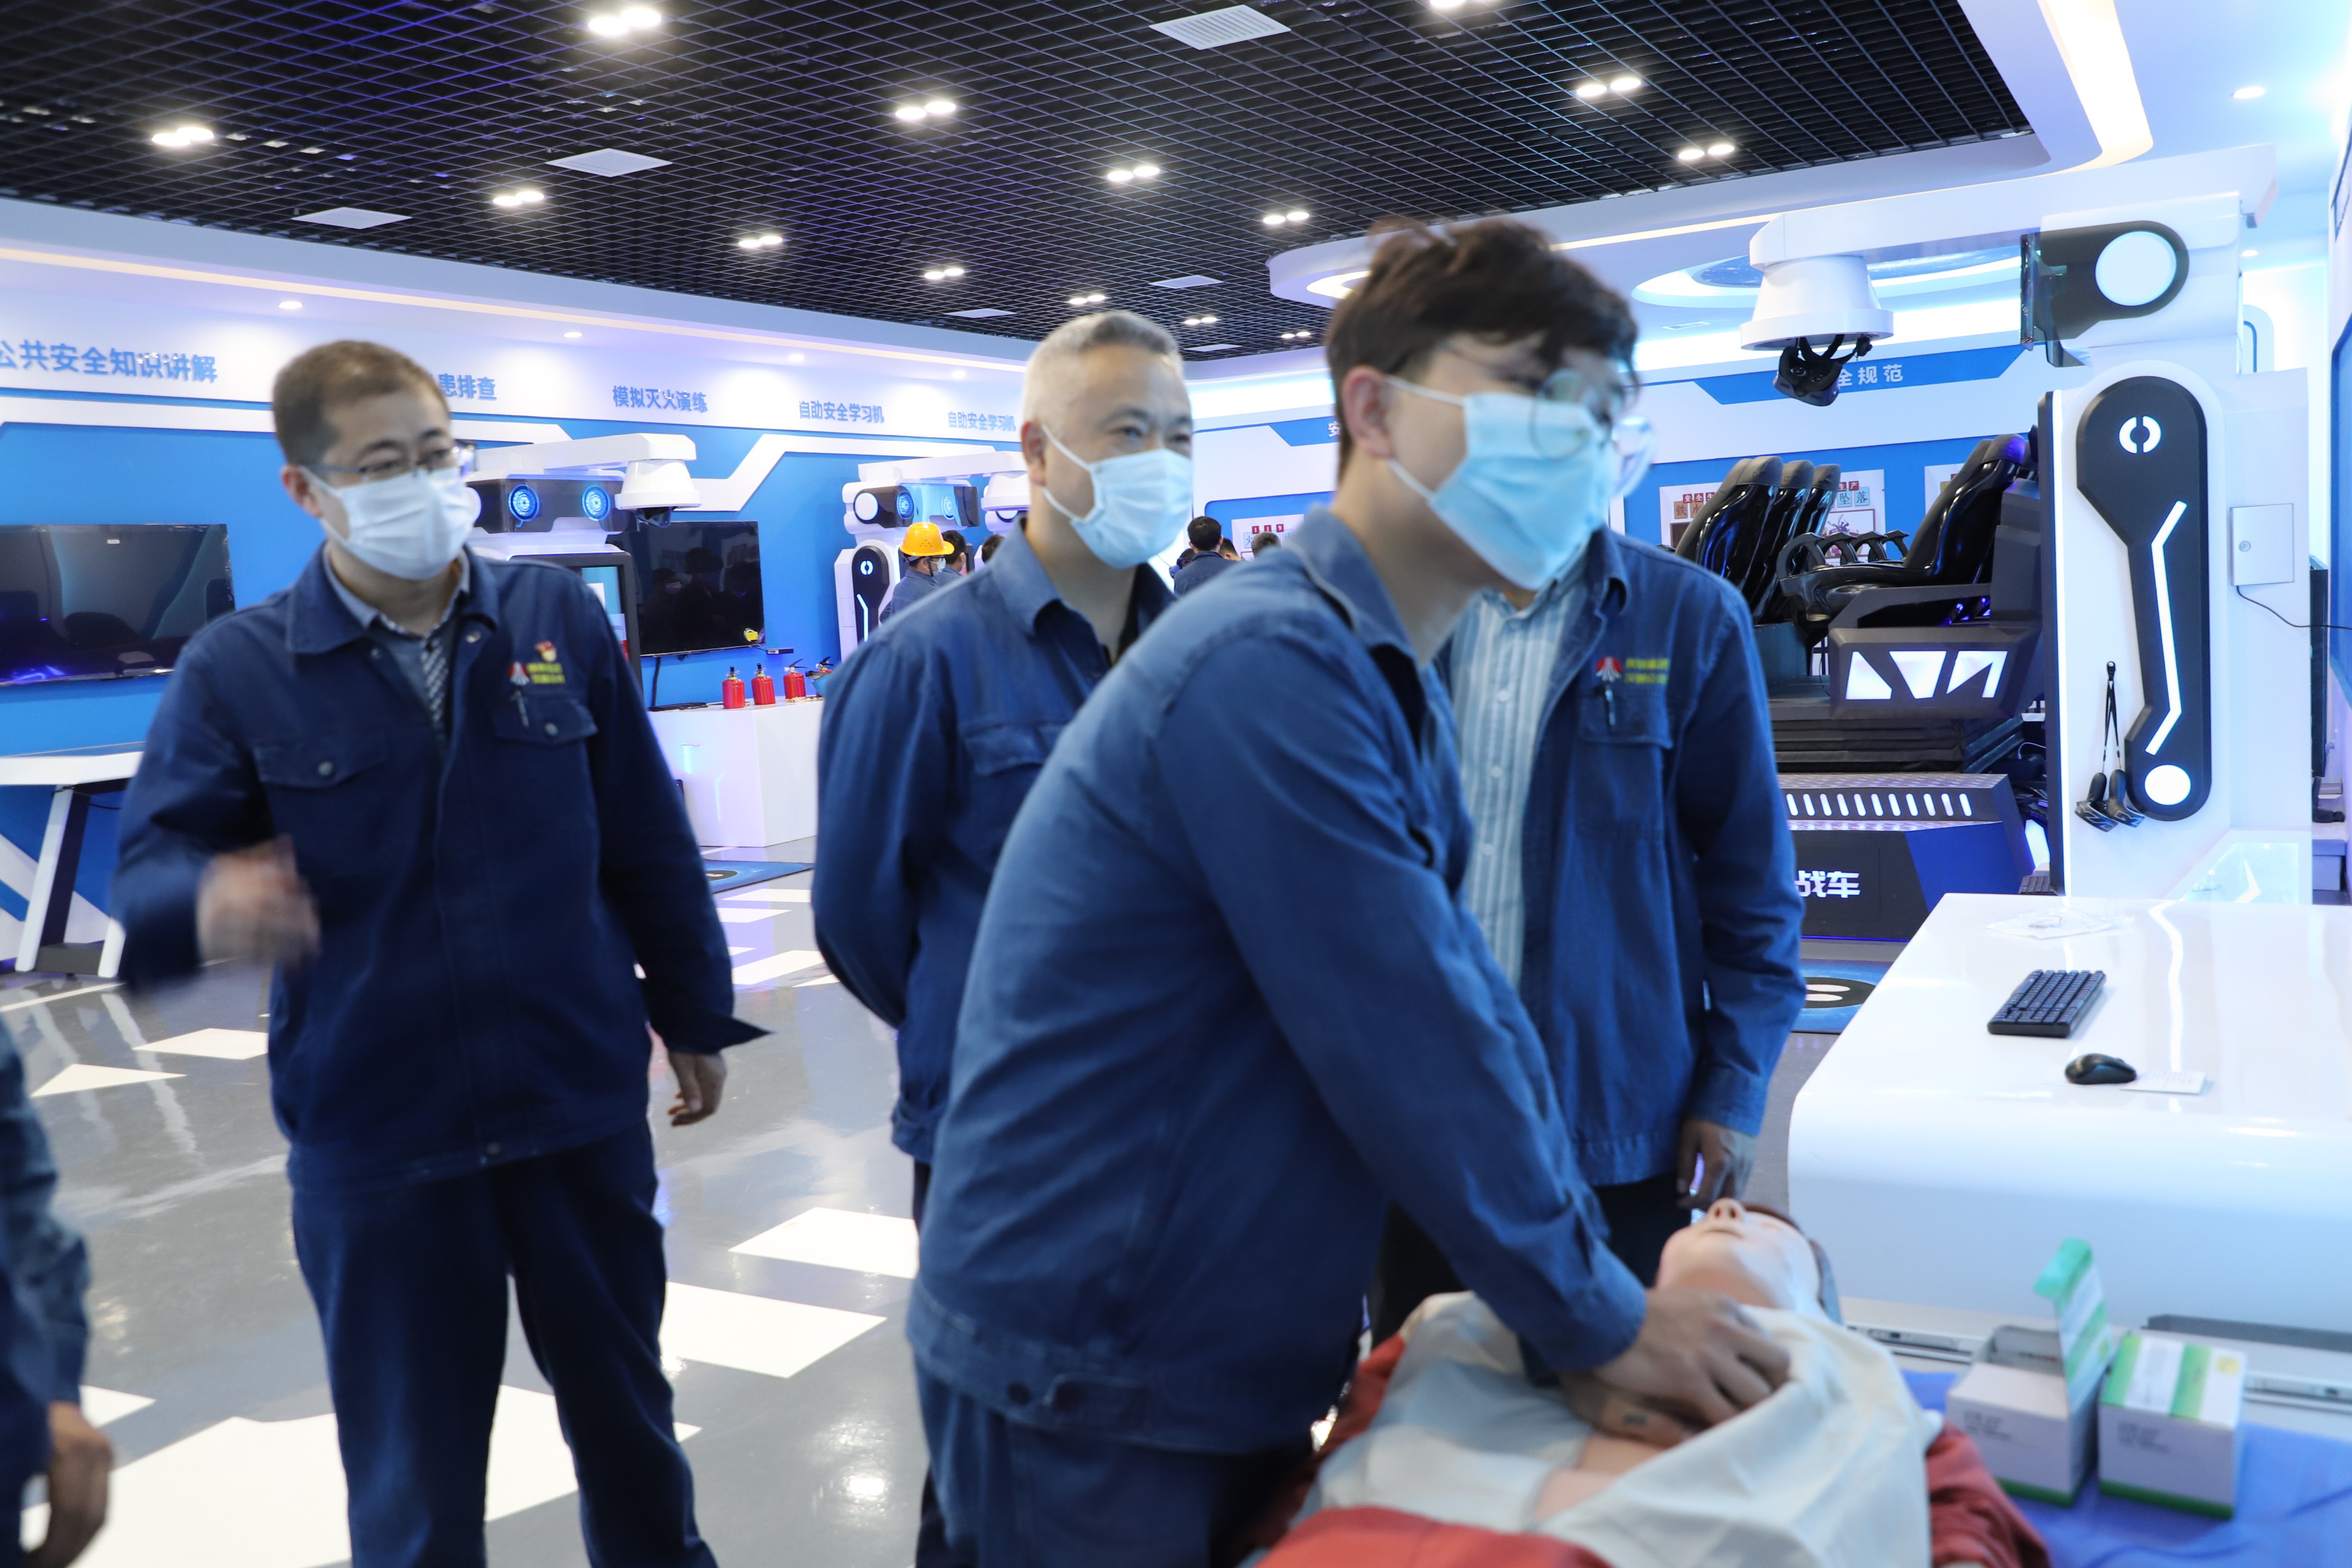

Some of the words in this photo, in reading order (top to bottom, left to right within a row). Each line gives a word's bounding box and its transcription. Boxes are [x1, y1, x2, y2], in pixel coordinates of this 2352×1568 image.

[0, 339, 218, 383] 公共安全知识讲解
[436, 373, 498, 400] 患排查
[1838, 364, 1903, 387] 全规范
[612, 385, 709, 413] 模拟灭火演练
[798, 401, 885, 424] 自助安全学习机
[948, 410, 1017, 432] 自助安全学习机
[1839, 492, 1868, 505] 坠落
[1794, 870, 1861, 899] 战车
